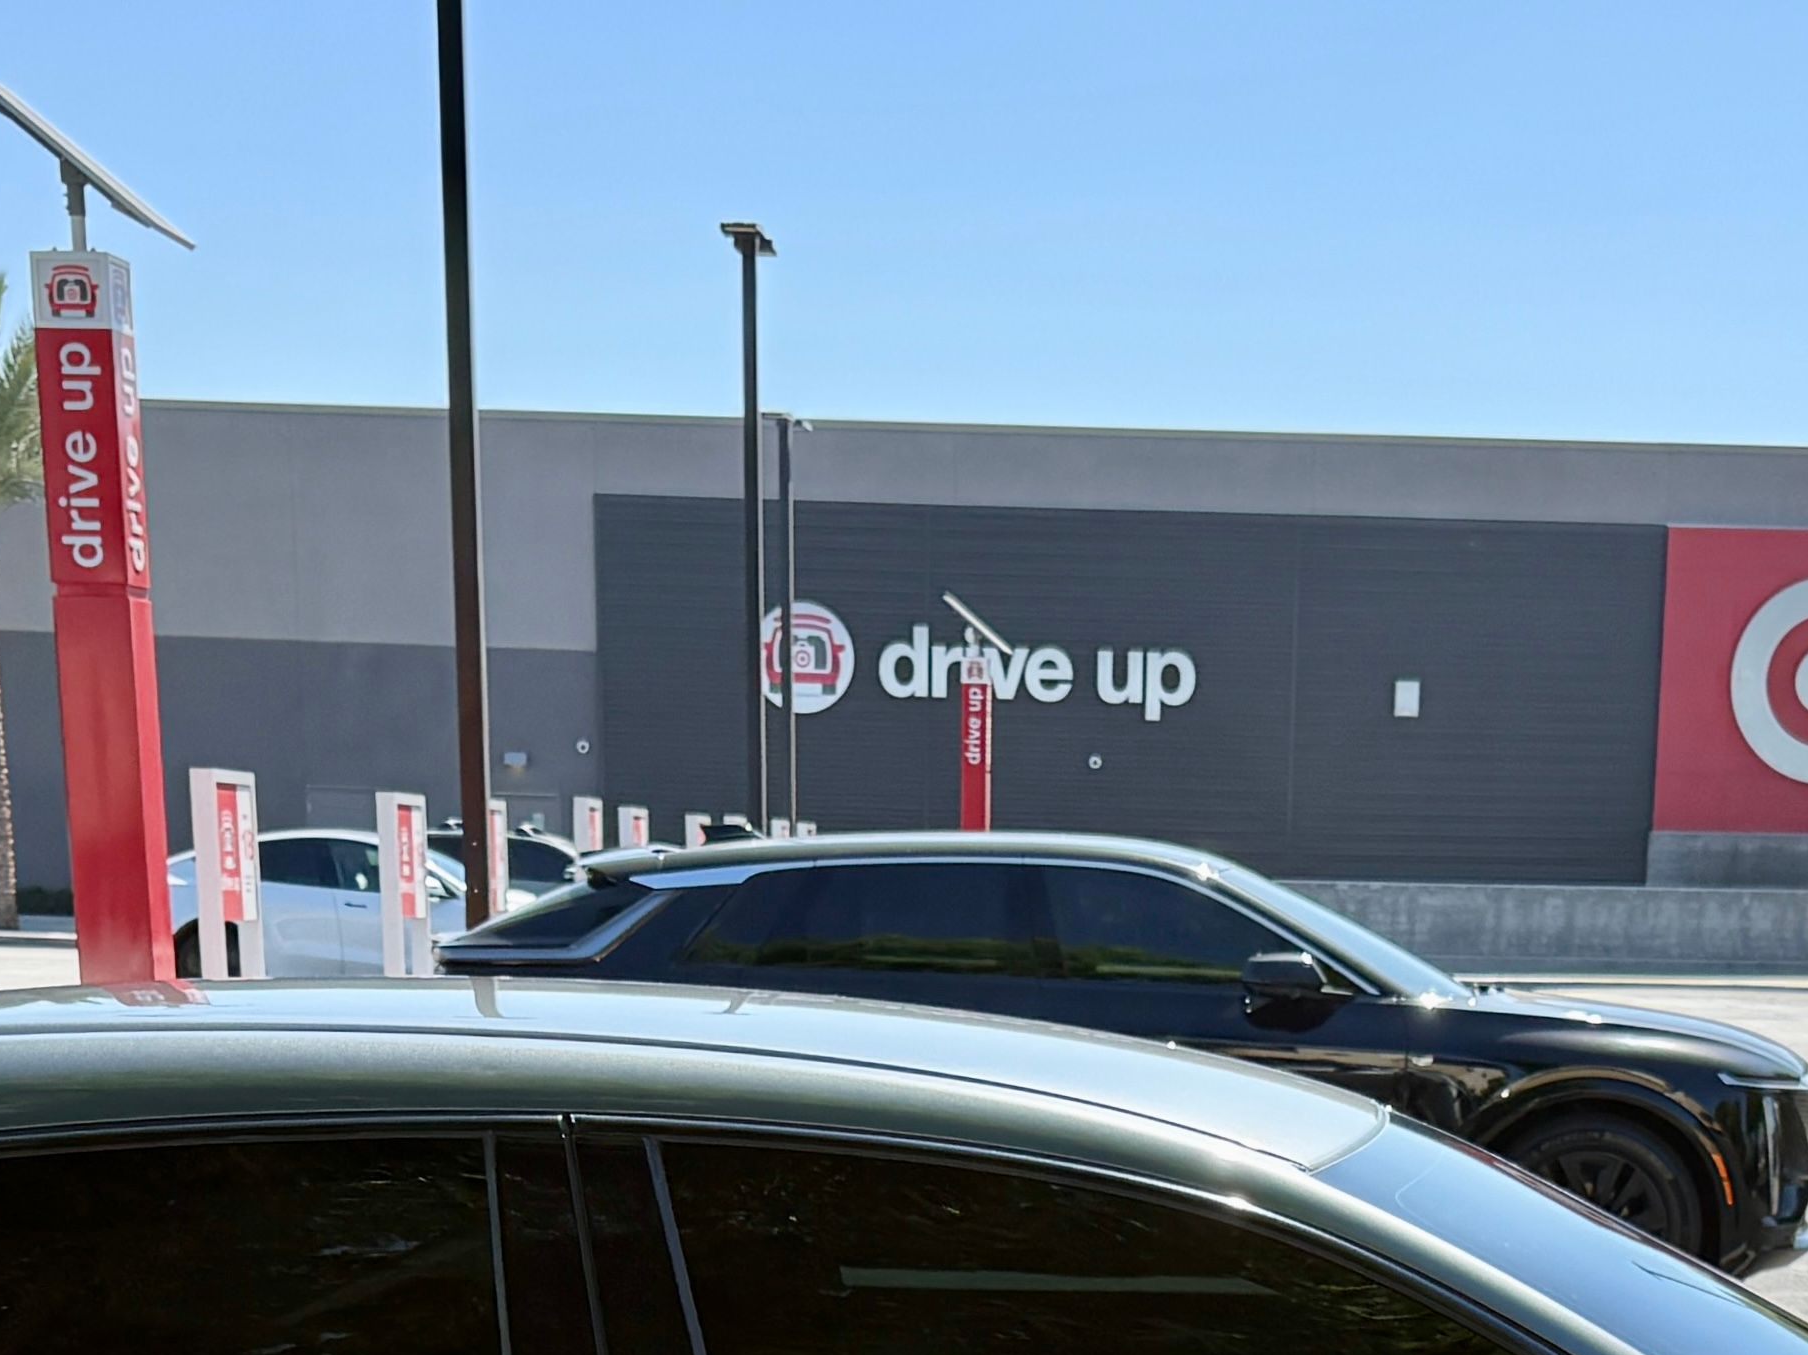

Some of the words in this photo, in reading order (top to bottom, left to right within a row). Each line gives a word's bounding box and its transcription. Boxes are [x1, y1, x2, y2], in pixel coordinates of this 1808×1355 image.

[59, 341, 102, 412] up
[57, 429, 105, 569] drive
[968, 686, 985, 712] up
[1096, 647, 1197, 722] up
[963, 717, 982, 766] drive
